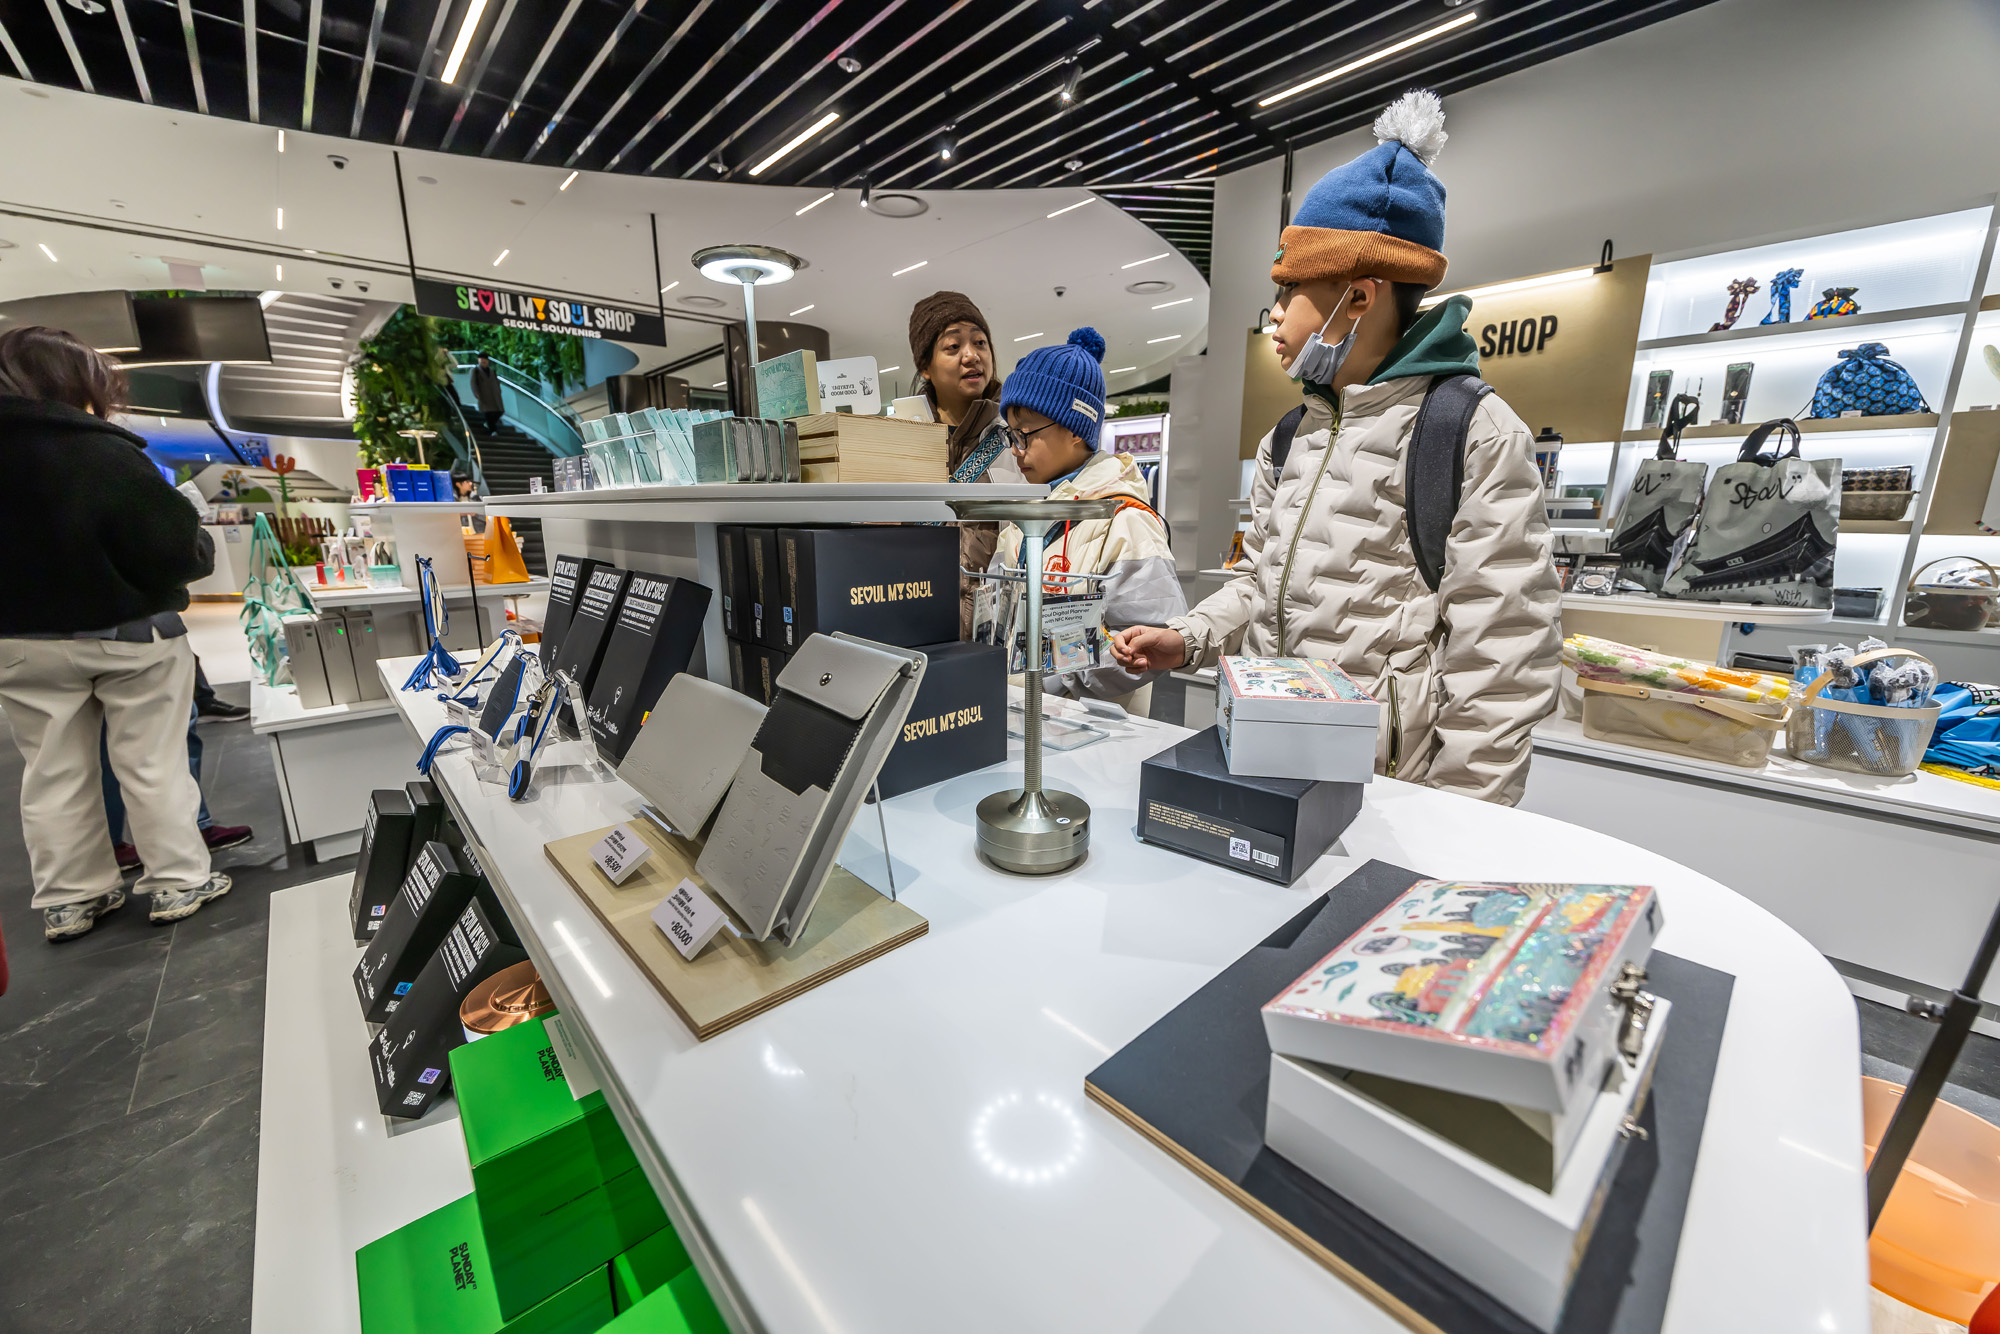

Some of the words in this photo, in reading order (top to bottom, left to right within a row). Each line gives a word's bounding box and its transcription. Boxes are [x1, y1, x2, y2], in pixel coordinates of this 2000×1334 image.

[503, 318, 540, 331] SEOUL
[542, 324, 602, 339] SOUVENIRS
[594, 307, 636, 333] SHOP
[1480, 315, 1558, 358] SHOP
[850, 584, 886, 605] SEOUL
[904, 718, 938, 742] SEOUL
[957, 705, 983, 727] SOUL
[536, 1049, 556, 1082] PLANET
[545, 1046, 564, 1078] SUNDAY
[448, 1246, 466, 1291] PLANET
[458, 1241, 476, 1285] SUNDAY
